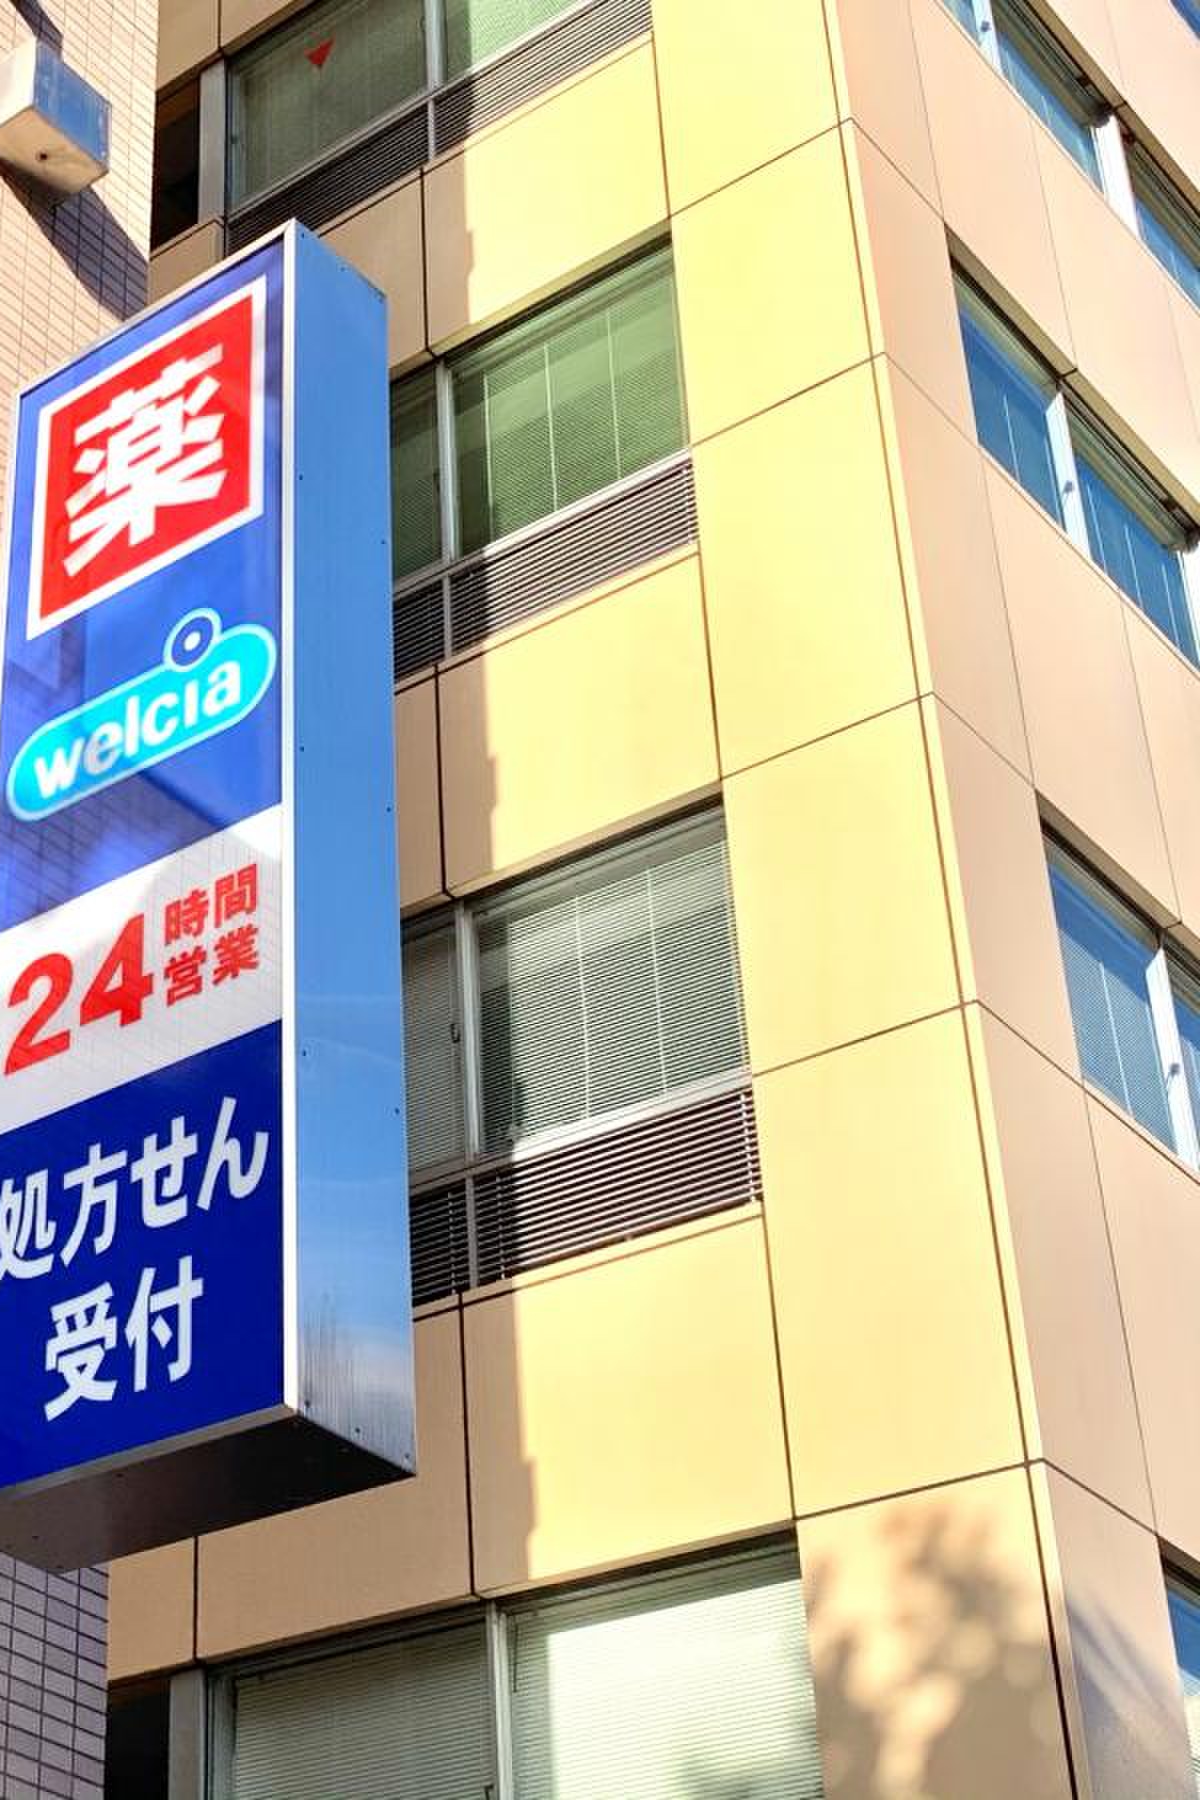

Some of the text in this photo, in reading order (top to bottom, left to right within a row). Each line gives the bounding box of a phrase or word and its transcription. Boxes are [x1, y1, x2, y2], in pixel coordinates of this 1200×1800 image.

[63, 343, 227, 577] 薬
[33, 658, 242, 800] welcia
[163, 924, 260, 1005] 営業
[44, 1255, 204, 1422] 受付
